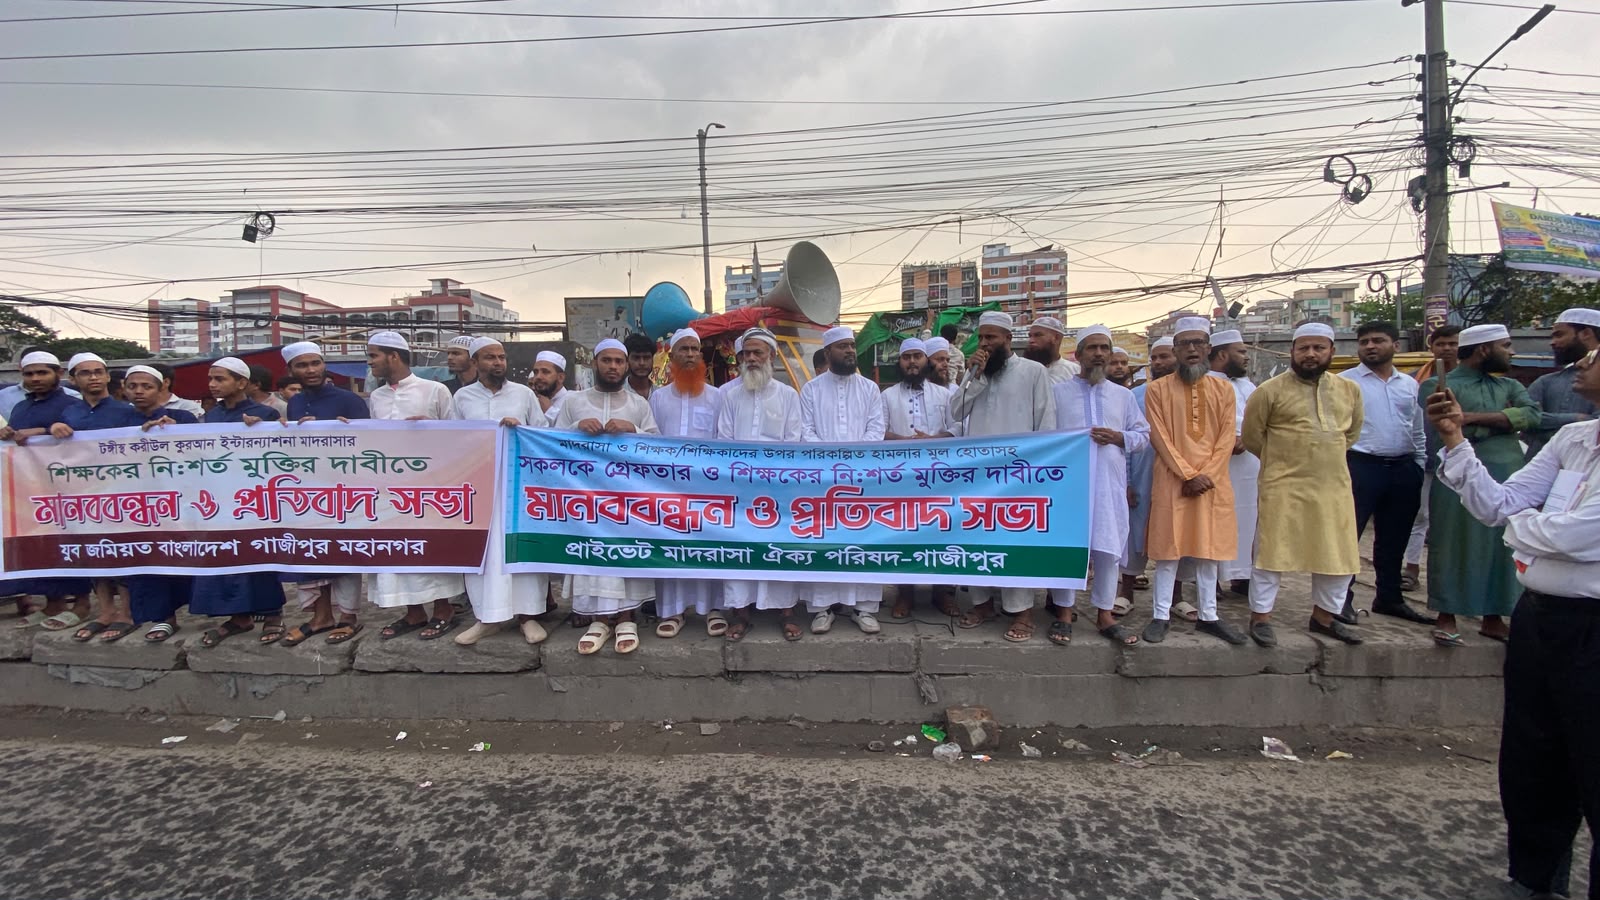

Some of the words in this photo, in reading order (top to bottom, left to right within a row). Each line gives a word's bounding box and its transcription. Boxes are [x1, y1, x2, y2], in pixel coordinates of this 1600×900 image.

[129, 439, 170, 454] করীউল
[174, 438, 216, 454] কুরআন
[300, 434, 357, 448] মাদরাসার
[558, 438, 612, 453] মাদরাসা
[617, 443, 629, 452] ও
[762, 447, 797, 460] উপর
[801, 447, 867, 461] পরিকল্পিত
[871, 447, 923, 460] হামলার
[956, 445, 1019, 458] হোতাসহ
[47, 462, 142, 484] শিক্ষকের
[239, 450, 320, 480] মুক্তির
[328, 449, 432, 475] দাবীতে
[518, 456, 599, 477] সকলকে
[604, 460, 694, 481] গ্রেফতার
[702, 466, 720, 481] ও
[729, 461, 825, 485] শিক্ষকের
[912, 461, 979, 489] মুক্তির
[984, 459, 1068, 484] দাবীতে
[30, 490, 182, 530] মানববন্ধন
[191, 488, 220, 520] ও
[232, 474, 379, 522] প্রতিবাদ
[387, 482, 476, 525] সভা
[524, 486, 739, 535] মানববন্ধন
[745, 495, 781, 529] ও
[789, 485, 955, 540] প্রতিবাদ
[959, 495, 1053, 534] সভা
[59, 543, 82, 563] যুব
[86, 538, 154, 558] জমিয়ত
[158, 538, 242, 558] বাংলাদেশ
[250, 533, 332, 559] গাজীপুর
[337, 537, 428, 557] মহানগর
[565, 538, 655, 562] প্রাইভেট
[660, 545, 755, 564] মাদরাসা
[762, 542, 817, 566] ঐক্য
[824, 545, 1008, 573] পরিষদ-গাজীপুর
